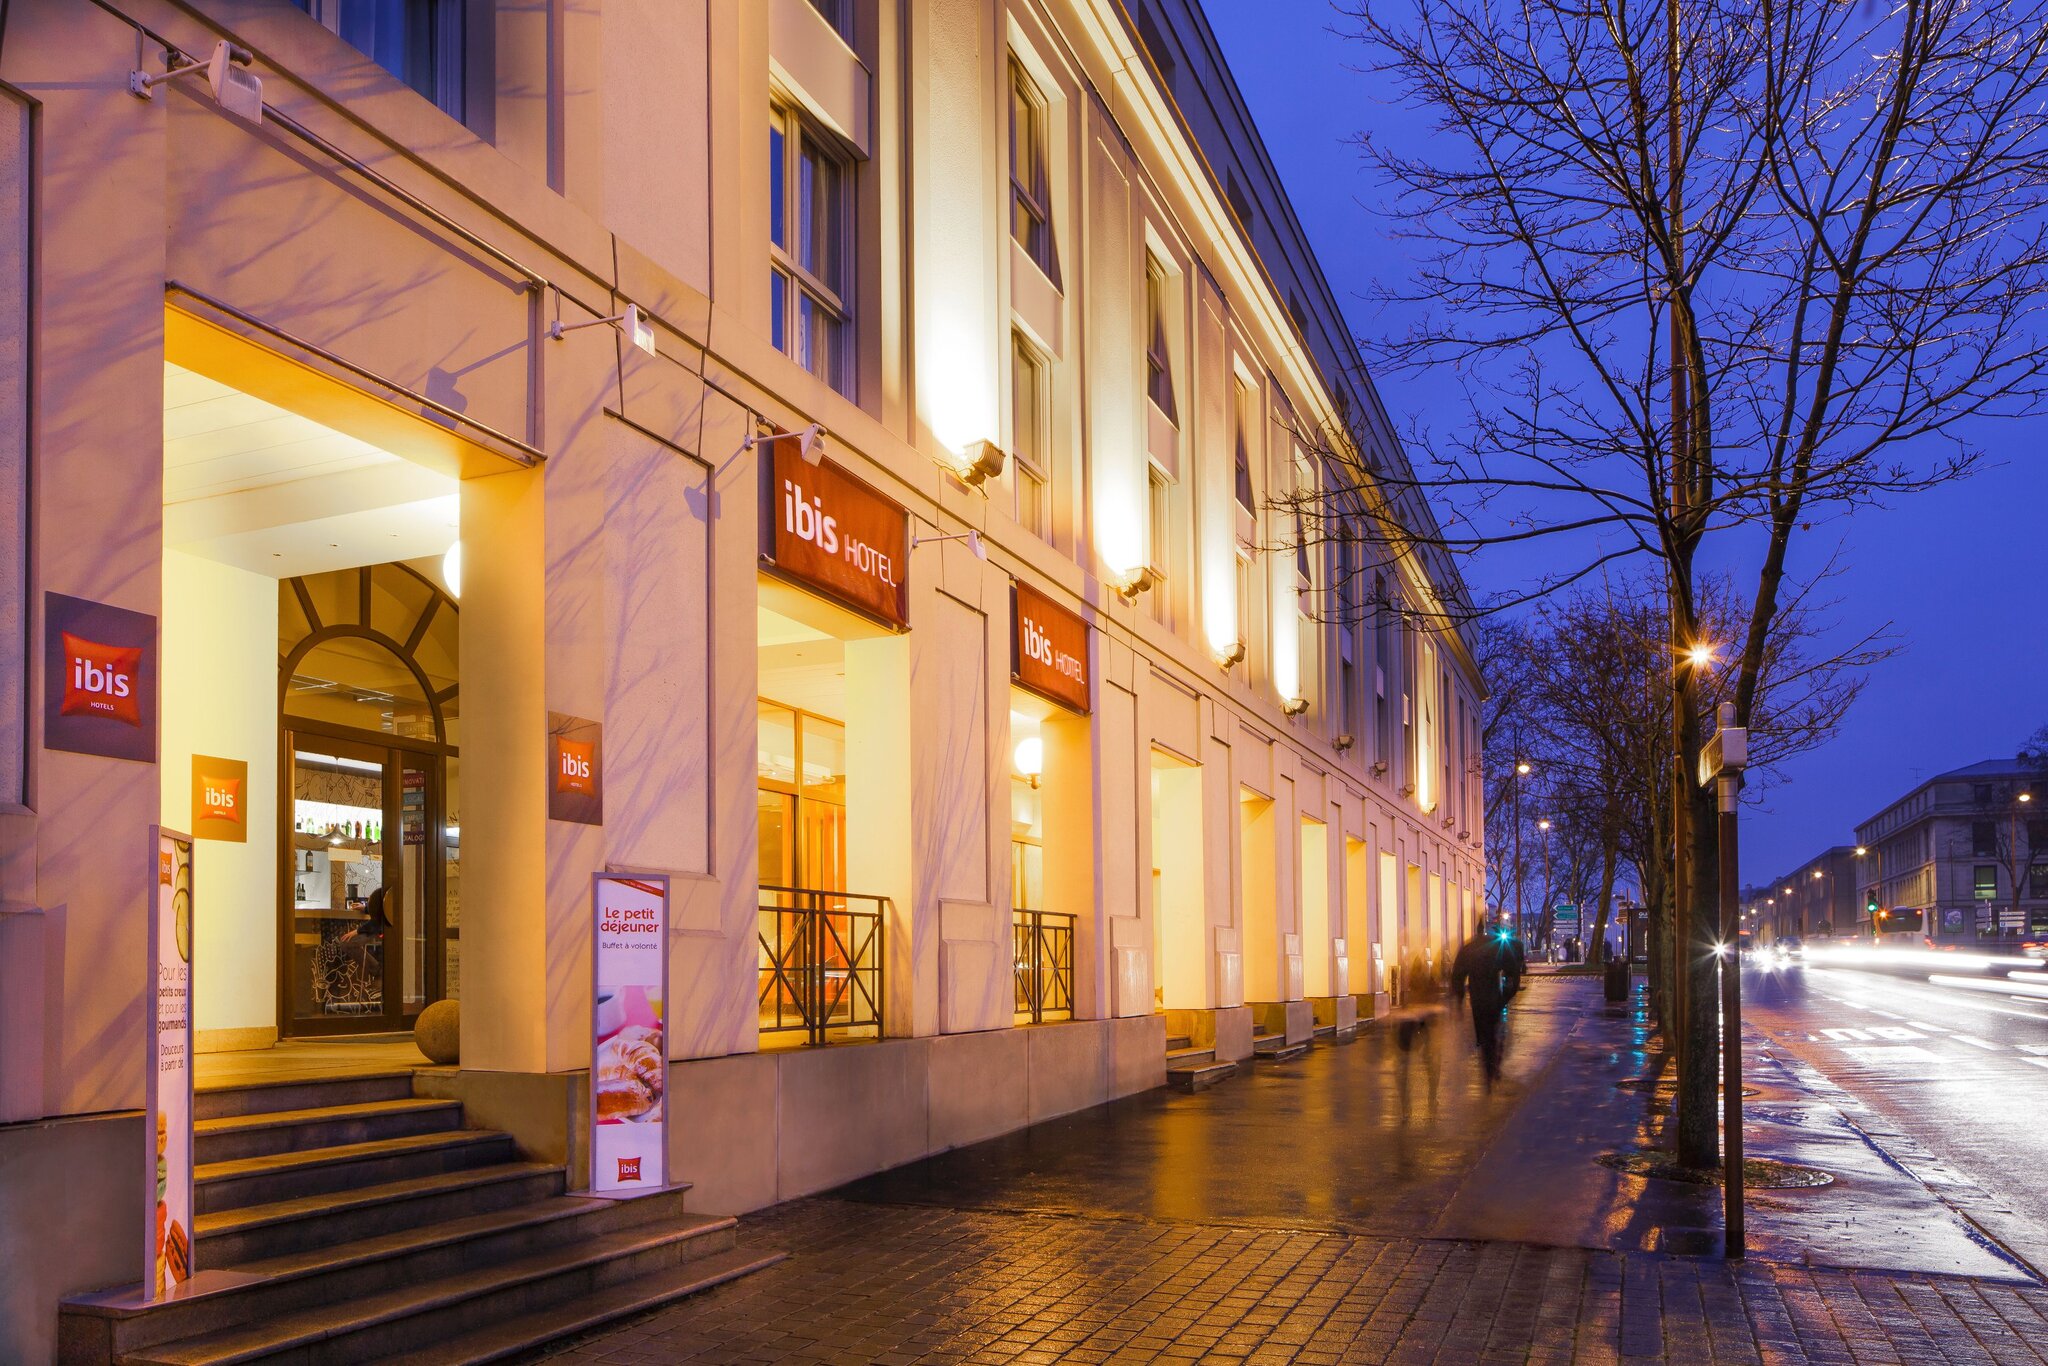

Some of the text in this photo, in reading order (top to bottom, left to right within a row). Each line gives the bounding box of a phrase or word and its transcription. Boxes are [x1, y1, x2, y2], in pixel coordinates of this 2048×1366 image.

[785, 479, 896, 587] ibis HOTEL
[1024, 616, 1085, 684] ibis HOTEL
[75, 657, 129, 697] ibis
[91, 701, 114, 711] HOTELS
[562, 752, 589, 778] ibis
[205, 787, 234, 807] ibis
[605, 907, 654, 921] Le petit
[600, 920, 660, 934] déjeuner
[160, 1044, 185, 1056] Douceurs
[621, 1164, 638, 1174] ibis
